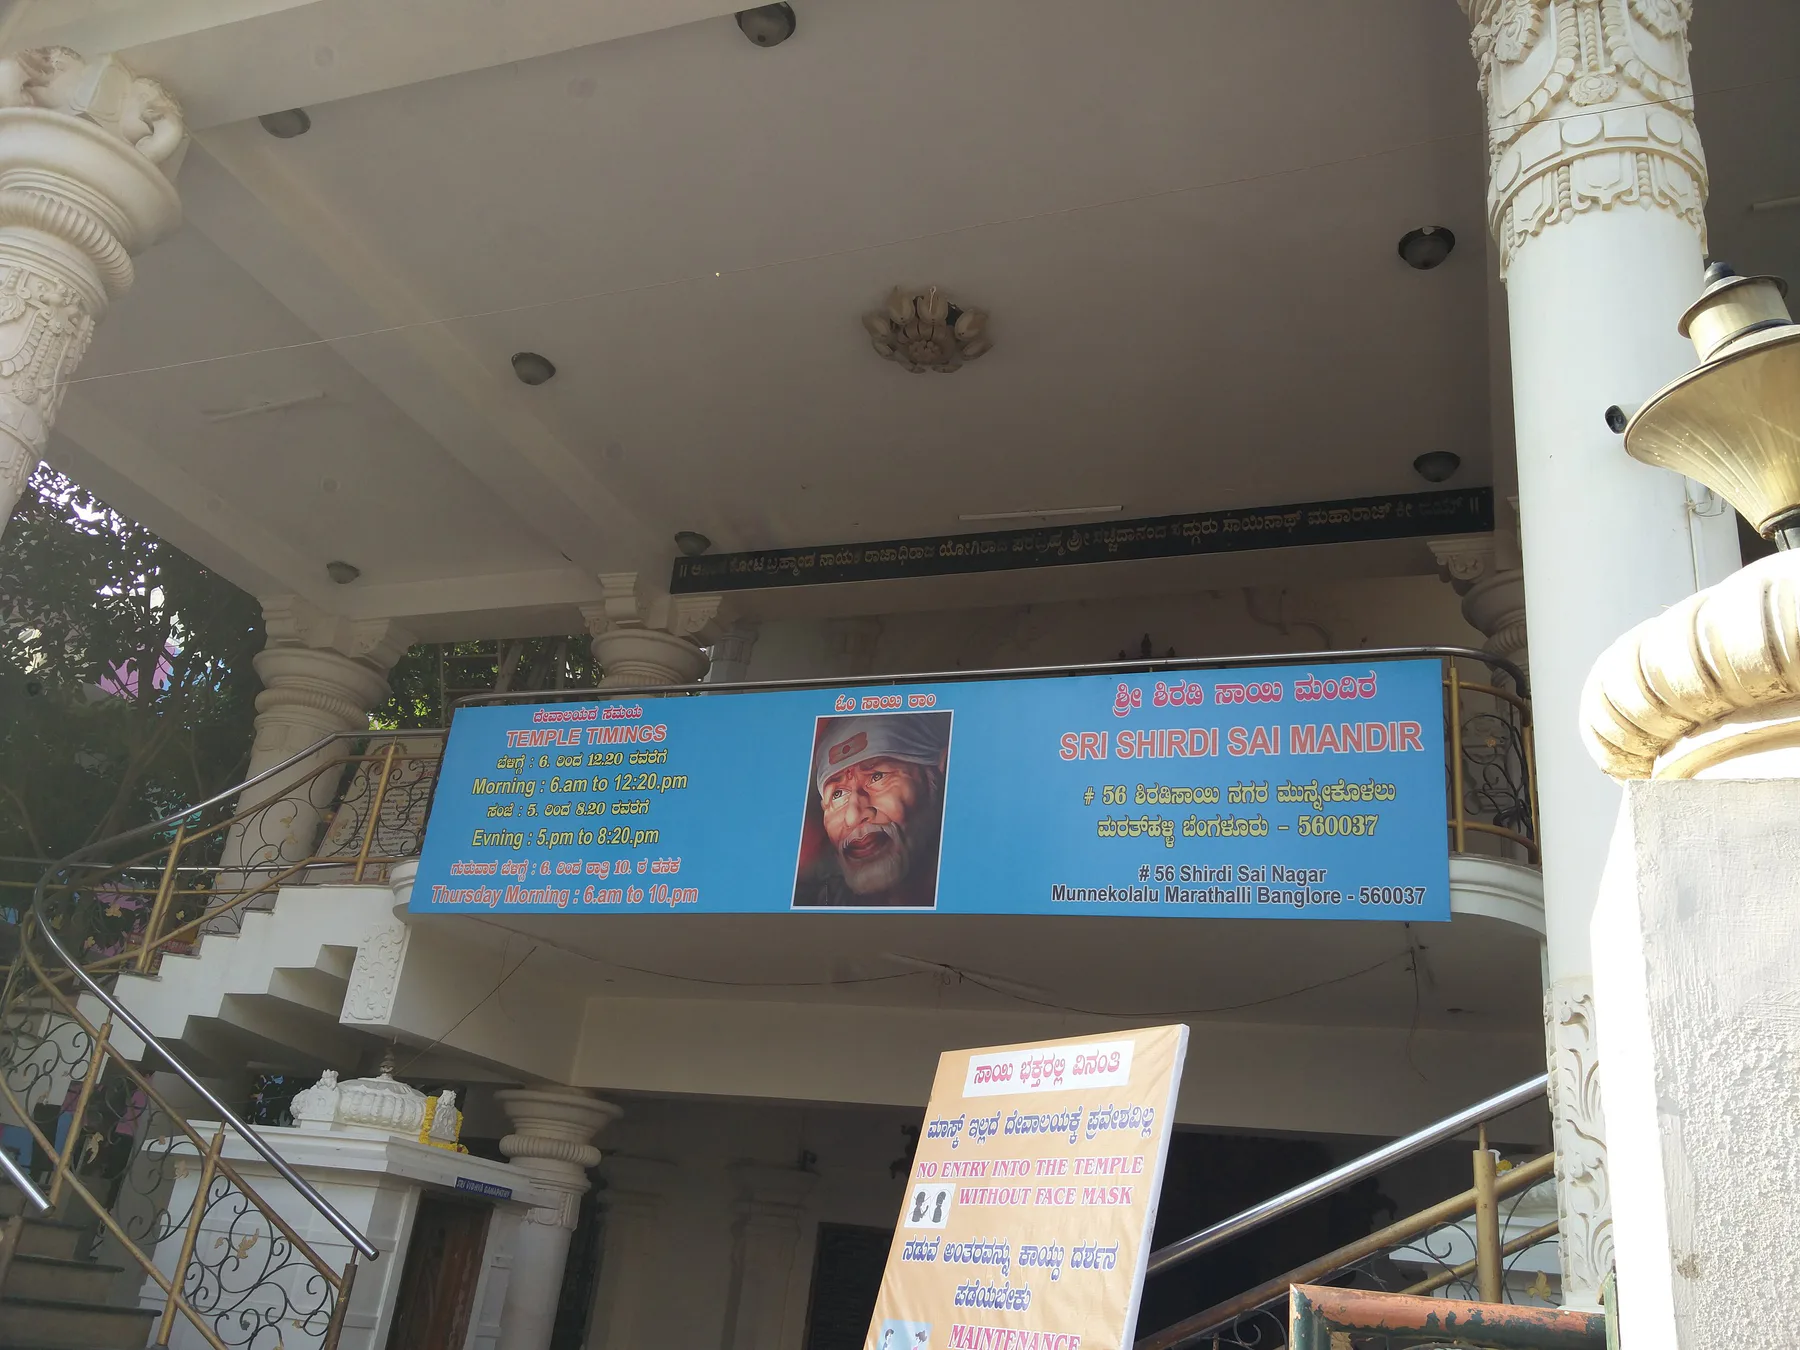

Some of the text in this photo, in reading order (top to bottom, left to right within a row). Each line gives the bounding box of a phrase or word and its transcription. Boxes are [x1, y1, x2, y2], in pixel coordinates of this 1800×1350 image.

[861, 695, 902, 710] ಸಾಯಿ
[908, 693, 937, 709] ರಾಂ
[1112, 670, 1377, 718] ಶ್ರೀ ಶಿರಡಿ ಸಾಯಿ ಮಂದಿರ
[532, 704, 643, 724] ದೇವಾಲಯದ ಸಮಯ
[506, 724, 667, 748] TEMPLE TIMINGS
[1059, 721, 1424, 761] SRI SHIRDI SAI MANDIR
[496, 754, 525, 774] ಬೆಳಿಗ್ಗೆ
[555, 752, 583, 767] ರಿಂದ
[587, 752, 623, 767] 12.20
[628, 748, 668, 765] ರವರೆಗೆ
[471, 777, 536, 798] Morning
[549, 776, 588, 793] 6.am
[592, 775, 608, 792] to
[613, 773, 688, 793] 12:20.pm
[1102, 785, 1127, 805] 56
[1134, 782, 1220, 805] ಶಿರಡಿಸಾಯಿ
[1228, 780, 1269, 803] ನಗರ
[487, 802, 515, 818] ಸಂಜೆ
[544, 801, 572, 817] ರಿಂದ
[575, 802, 606, 817] 8.20
[611, 798, 650, 815] ರವರೆಗೆ
[1182, 813, 1269, 837] ಬೆಂಗಳೂರು
[1298, 814, 1378, 837] 560037
[471, 828, 523, 850] Evning
[536, 828, 574, 850] 5.pm
[577, 828, 593, 845] to
[596, 826, 660, 848] 8:20.pm
[450, 858, 497, 876] ಗುರುವಾರ
[500, 859, 529, 882] ಬೆಳಿಗ್ಗೆ
[555, 858, 582, 875] ರಿಂದ
[585, 859, 610, 880] ರಾತ್ರಿ
[614, 859, 632, 875] 10.
[636, 857, 648, 875] ರ
[651, 856, 682, 874] ತನಕ
[1154, 865, 1175, 882] 56
[1179, 864, 1232, 883] Shirdi
[1237, 864, 1266, 883] Sai
[1271, 865, 1327, 886] Nagar
[431, 884, 502, 908] Thursday
[504, 884, 570, 908] Morning
[583, 884, 623, 904] 6.am
[626, 884, 643, 903] to
[649, 883, 699, 907] 10.pm
[1052, 884, 1159, 903] Munnekolalu
[1164, 885, 1251, 903] Marathalli
[1257, 886, 1341, 908] Banglore
[1359, 886, 1426, 905] 560037
[974, 1049, 1121, 1088] ಸಾಯಿ ಭಕ್ತರಲ್ಲಿ ವಿನಂತಿ
[927, 1102, 1155, 1149] ಮಾಸ್ಕ್ ಇಲ್ಲದೆ ದೇವಾಲಯಕ್ಕೆ ಪ್ರವೇಶವಿಲ್ಲ
[916, 1155, 1144, 1179] NO ENTRY INTO THE TEMPLE
[958, 1185, 1134, 1205] WITHOUT FACE MASK
[902, 1235, 941, 1262] ನಡುವೆ
[943, 1236, 1010, 1277] ಅಂತರವನ್ನು
[1070, 1238, 1119, 1270] ದರ್ಶನ
[954, 1278, 1032, 1311] ಪಡೆಯಬೇಕು
[948, 1324, 1081, 1350] MAINTENANCE
